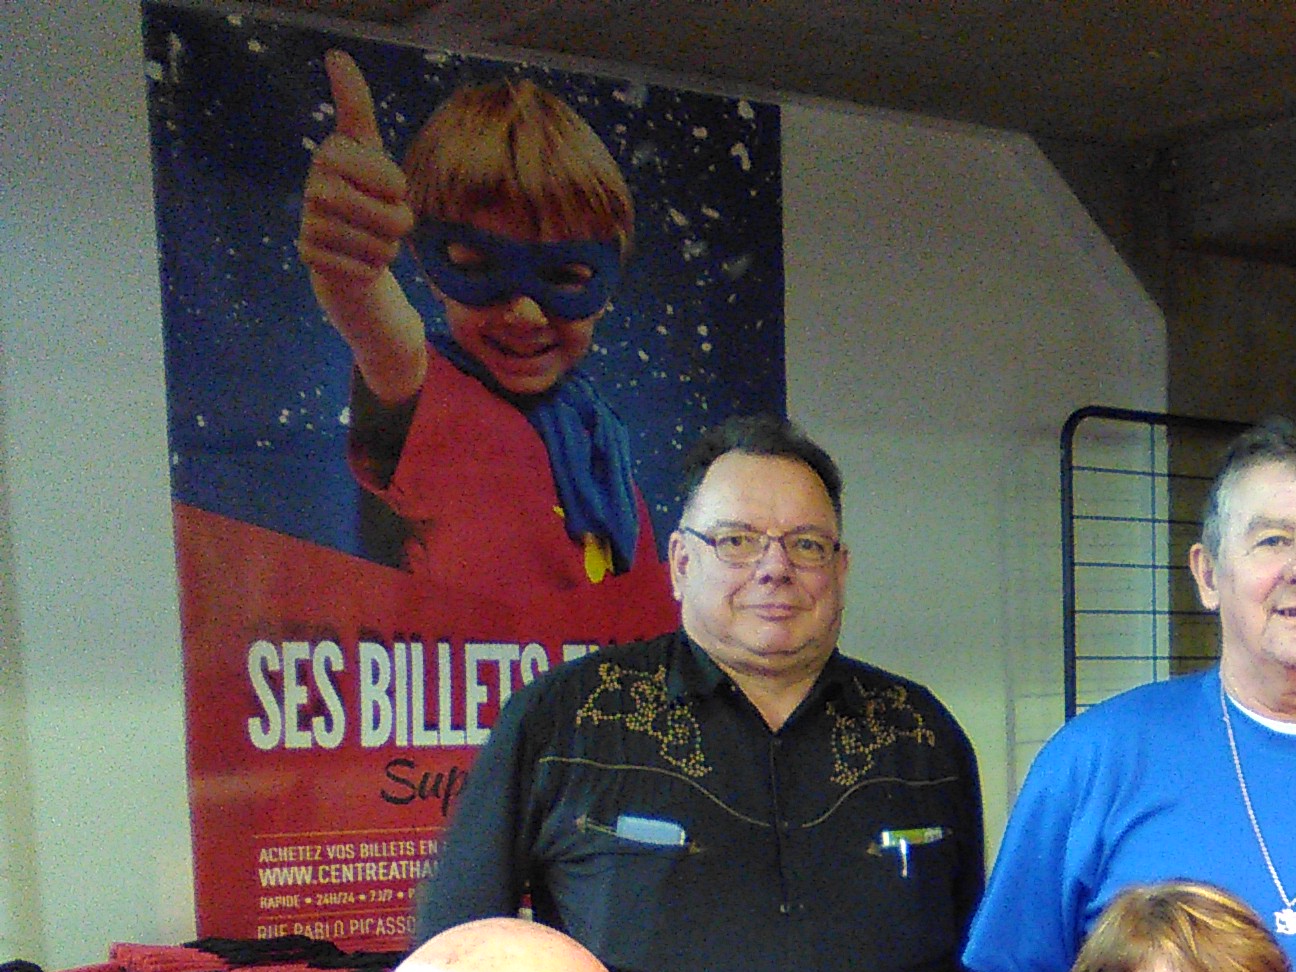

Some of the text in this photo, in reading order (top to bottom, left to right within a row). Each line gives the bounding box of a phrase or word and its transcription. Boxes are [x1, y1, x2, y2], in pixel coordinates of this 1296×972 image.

[248, 640, 346, 751] SES
[258, 839, 438, 863] ACHETEZ VOS BILLETS EN
[260, 895, 300, 909] RAPIDE
[350, 915, 417, 936] PICASSO
